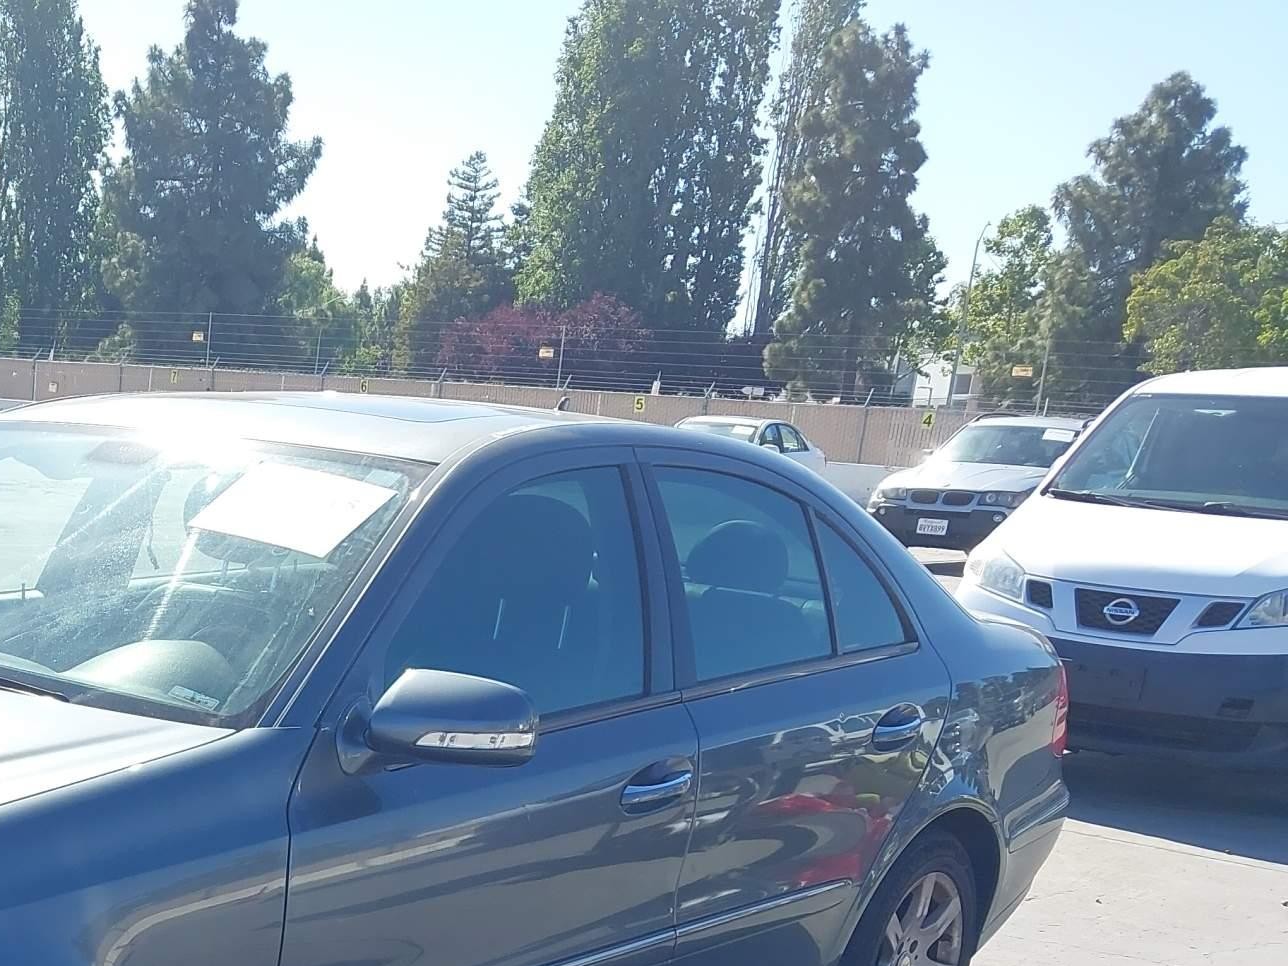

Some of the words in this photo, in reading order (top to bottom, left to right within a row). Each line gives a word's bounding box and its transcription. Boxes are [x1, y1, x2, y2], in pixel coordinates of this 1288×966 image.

[172, 371, 177, 381] 7
[361, 381, 367, 393] 6
[635, 398, 644, 410] 5
[922, 414, 932, 427] 4
[1106, 607, 1135, 615] NISSAN
